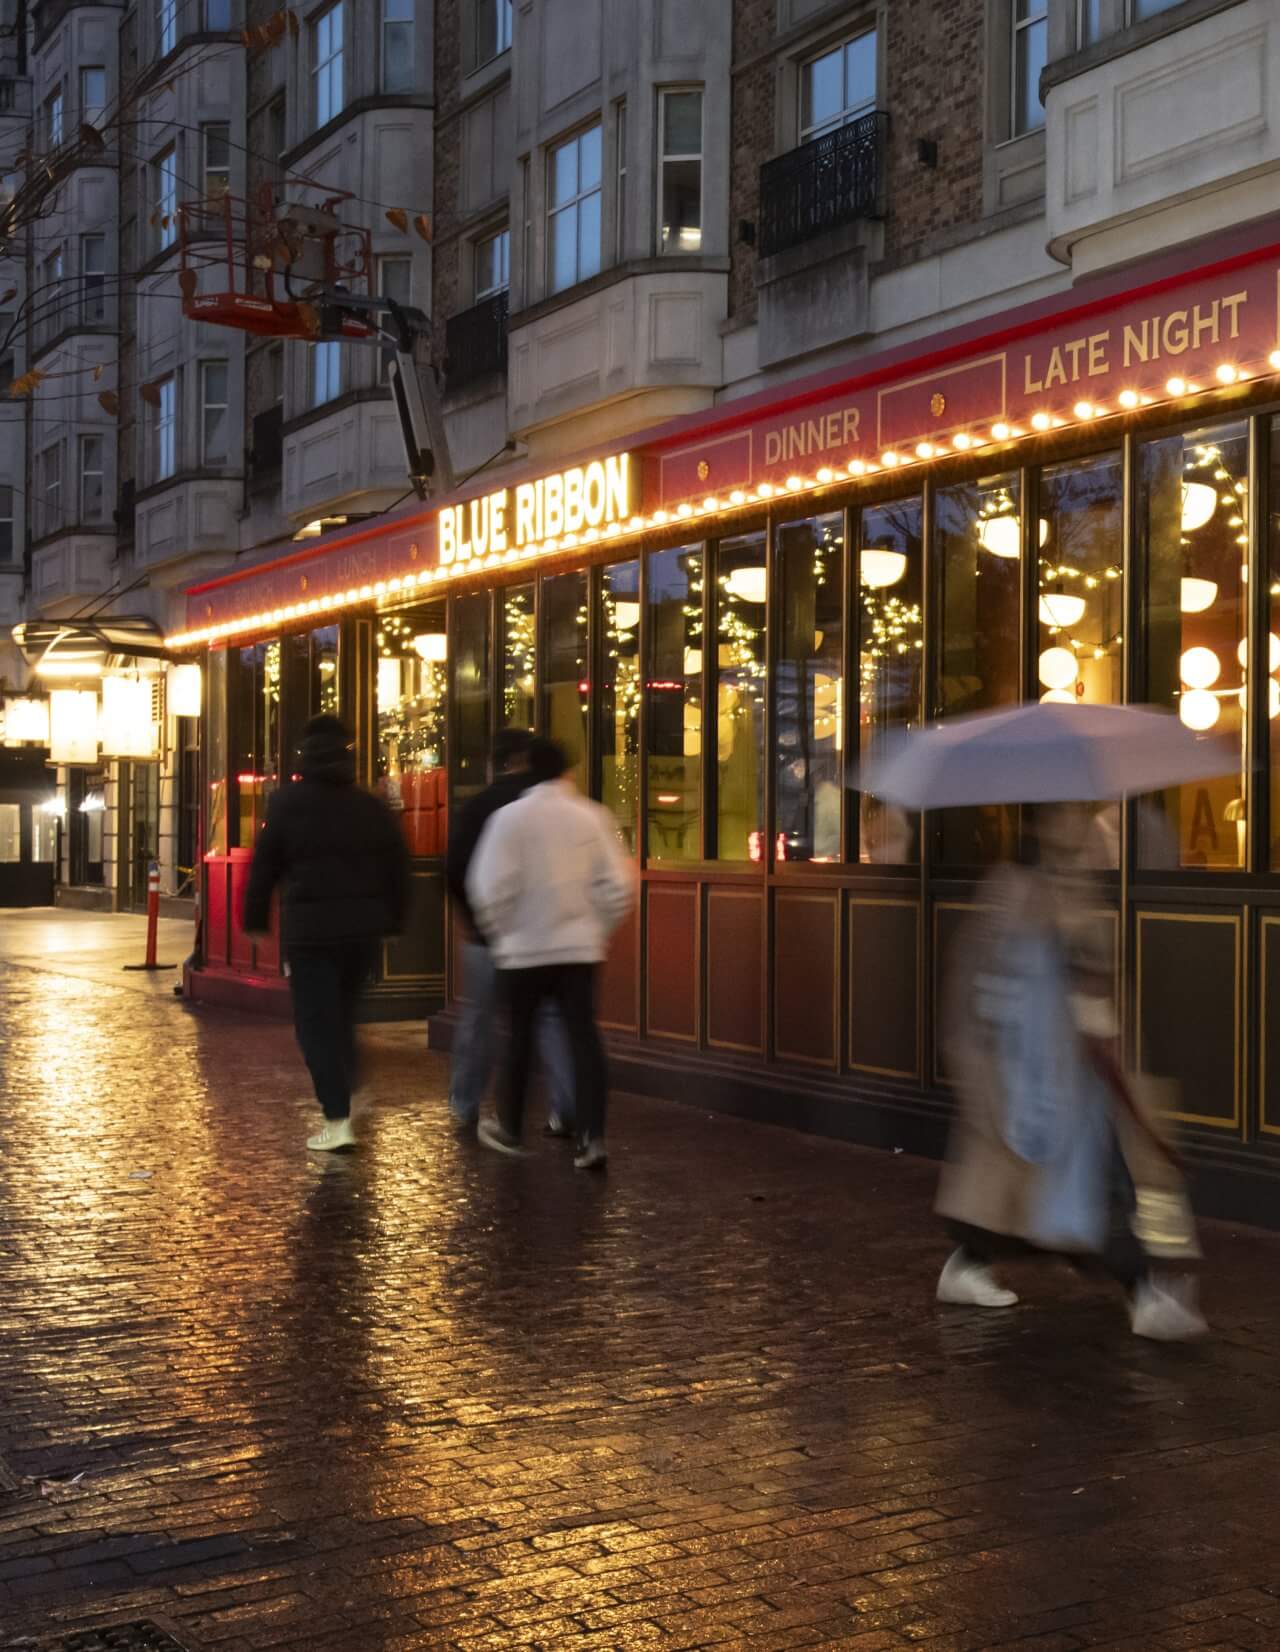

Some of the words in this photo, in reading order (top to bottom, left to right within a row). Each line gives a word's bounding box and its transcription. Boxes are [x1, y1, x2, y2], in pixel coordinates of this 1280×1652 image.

[1022, 329, 1110, 395] LATE
[1122, 290, 1248, 368] NIGHT
[764, 407, 860, 466] DINNER
[438, 487, 508, 566] BLUE
[515, 451, 631, 546] RIBBON
[336, 548, 377, 580] LUNCH
